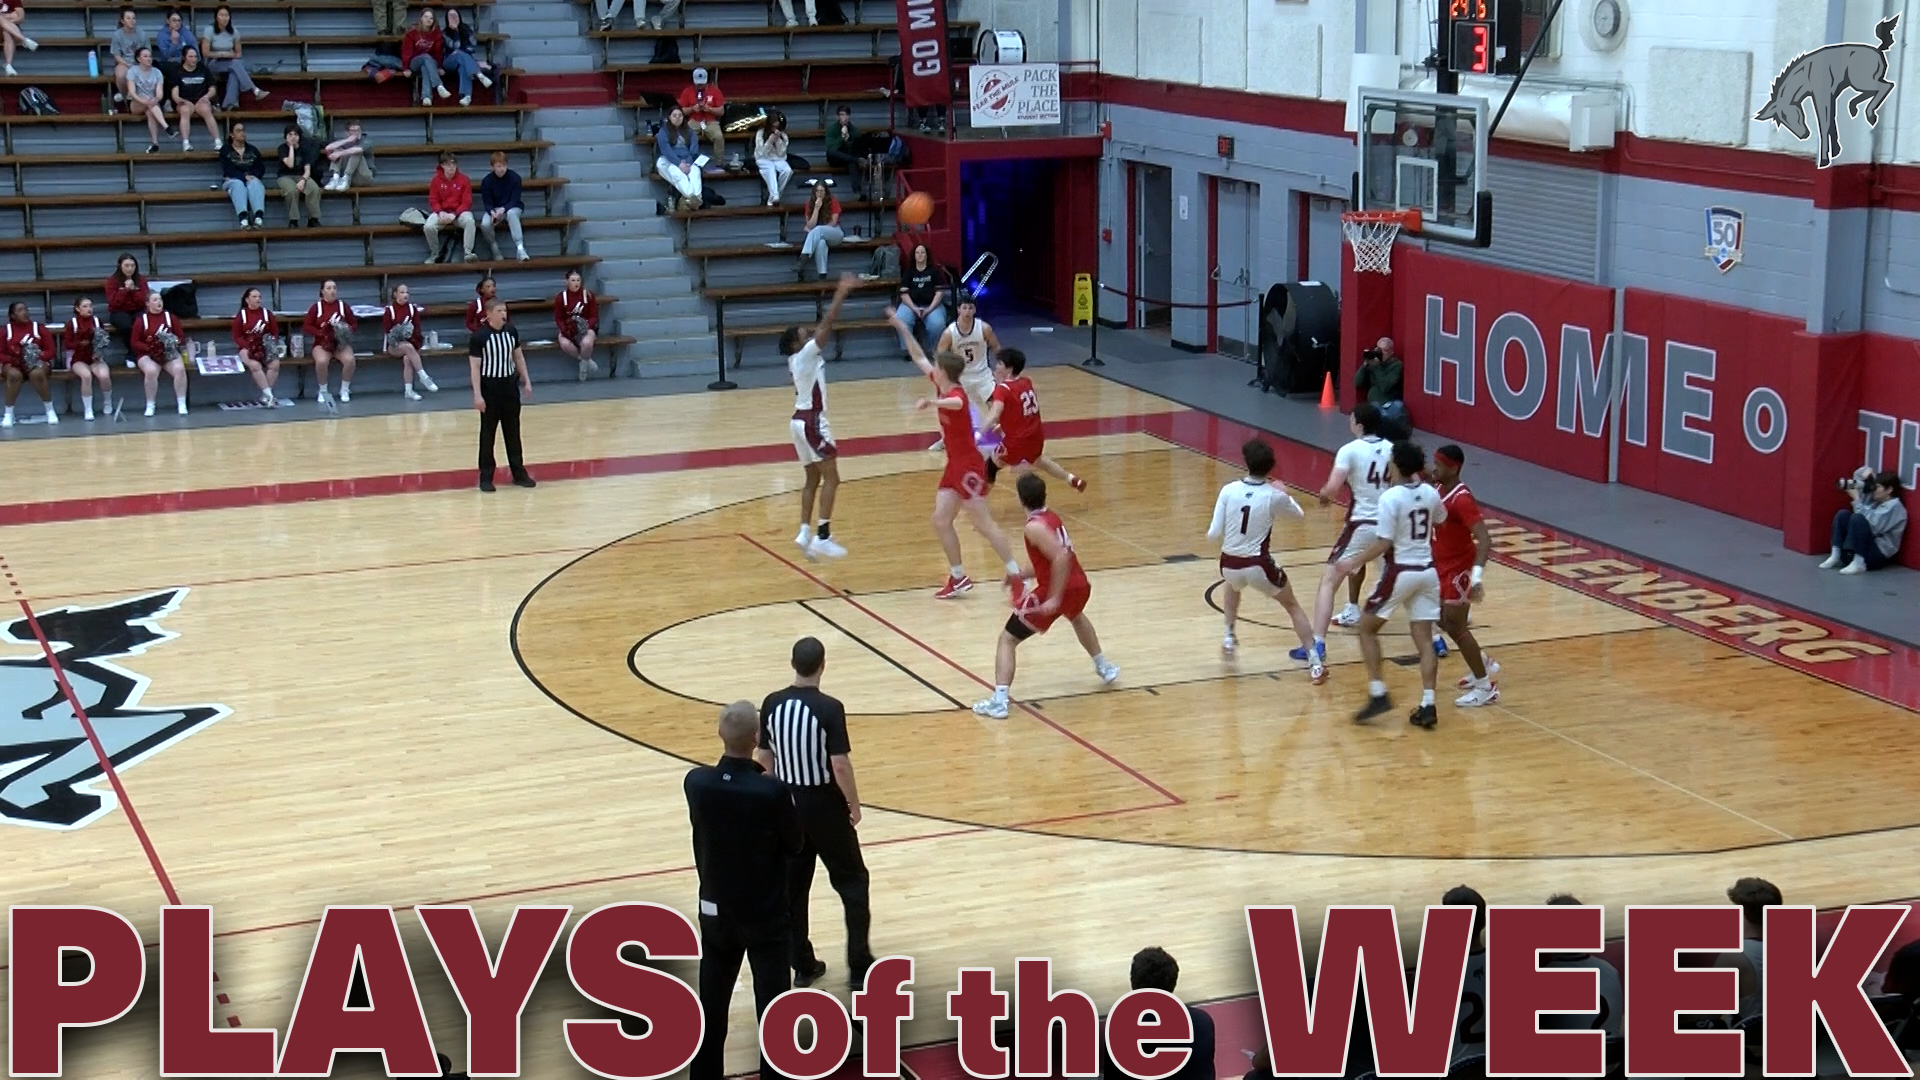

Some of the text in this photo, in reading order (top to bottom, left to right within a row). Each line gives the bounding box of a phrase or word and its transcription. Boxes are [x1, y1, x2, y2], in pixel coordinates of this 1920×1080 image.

[907, 0, 941, 76] GO M
[1472, 26, 1487, 71] 3
[1023, 69, 1057, 82] PACK
[1030, 83, 1058, 97] THE
[1017, 99, 1059, 114] PLACE
[1713, 221, 1736, 248] 50
[964, 348, 974, 364] 5
[1423, 294, 1716, 464] HOME
[1240, 505, 1251, 536] 1
[1408, 508, 1430, 540] 13
